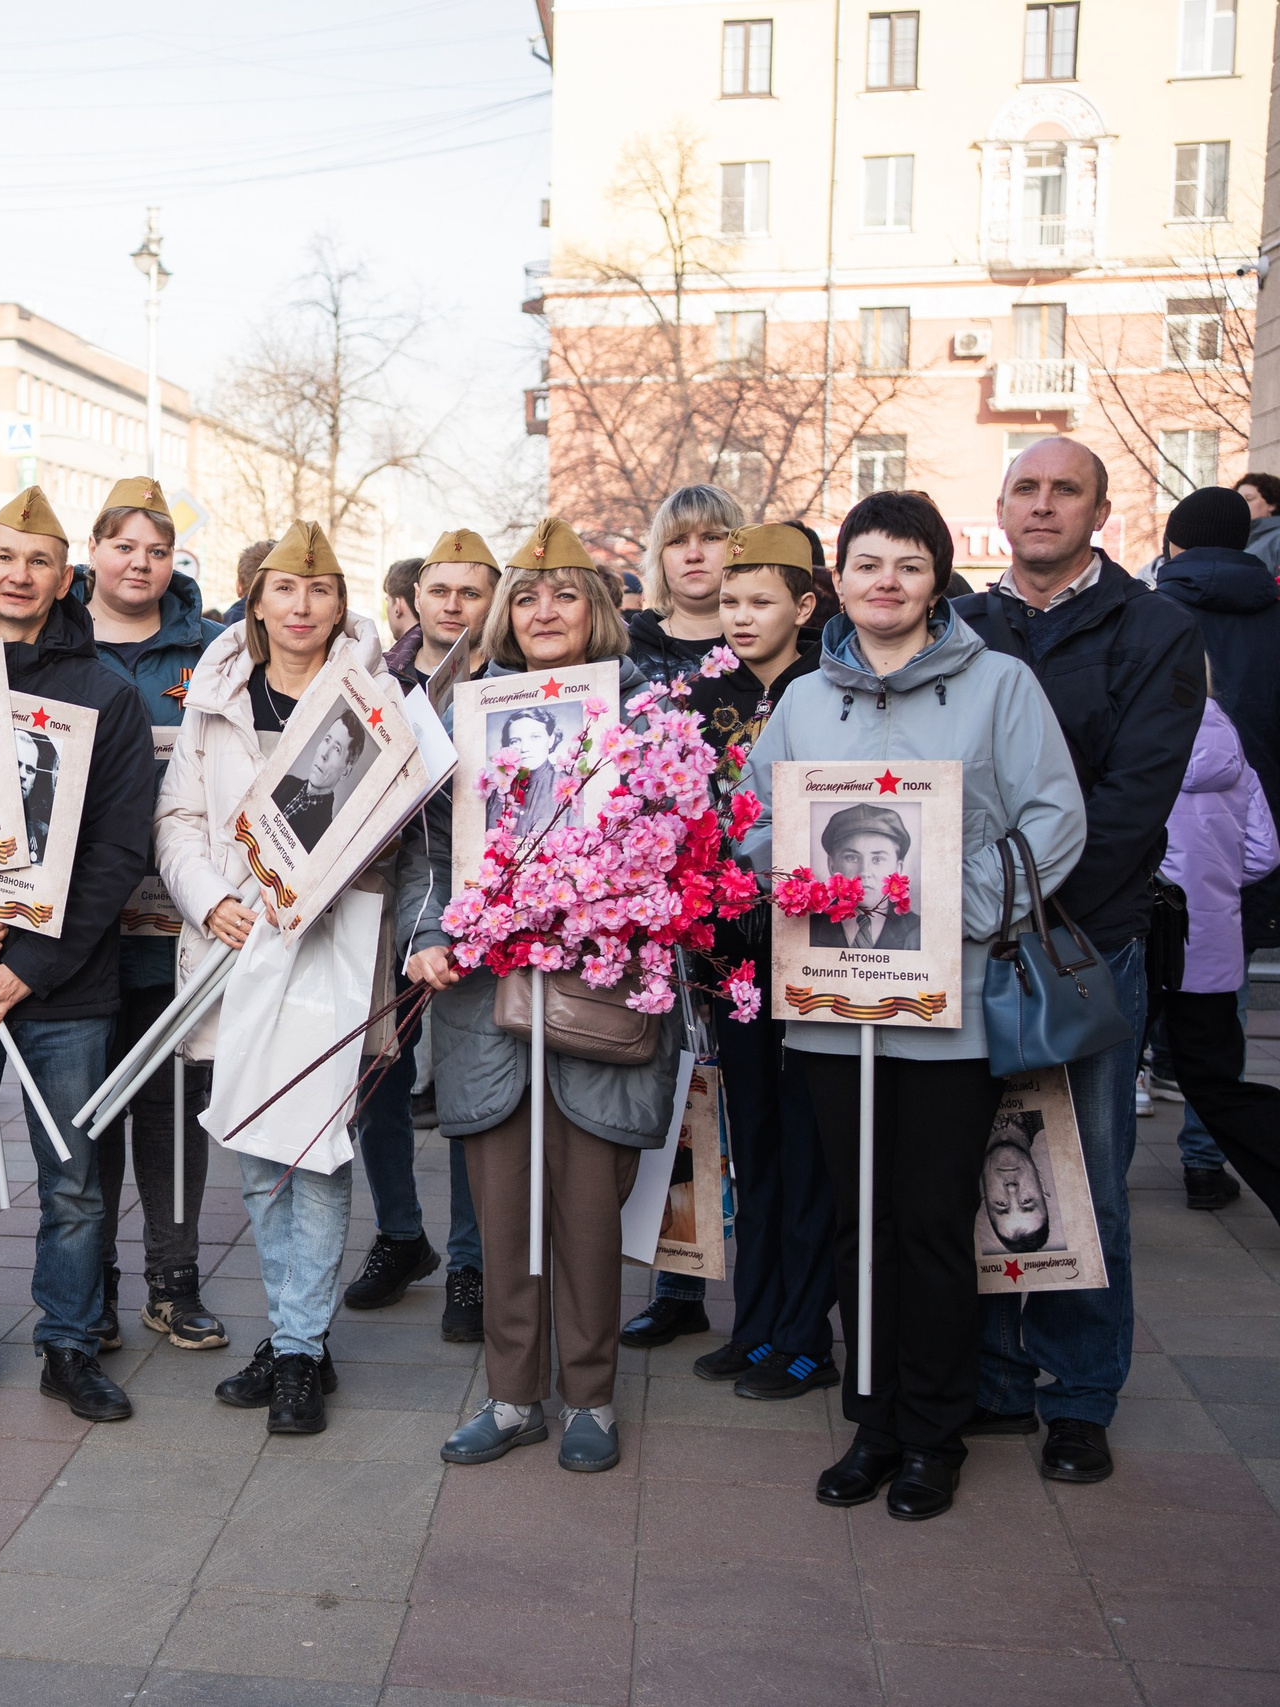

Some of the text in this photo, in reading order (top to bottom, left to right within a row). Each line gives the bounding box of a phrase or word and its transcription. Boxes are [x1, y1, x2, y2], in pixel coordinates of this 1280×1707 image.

[258, 813, 296, 871] Пётр Никитович
[272, 813, 297, 850] Богданов
[839, 950, 890, 964] Антонов
[801, 965, 929, 982] Филипп Терентьевич
